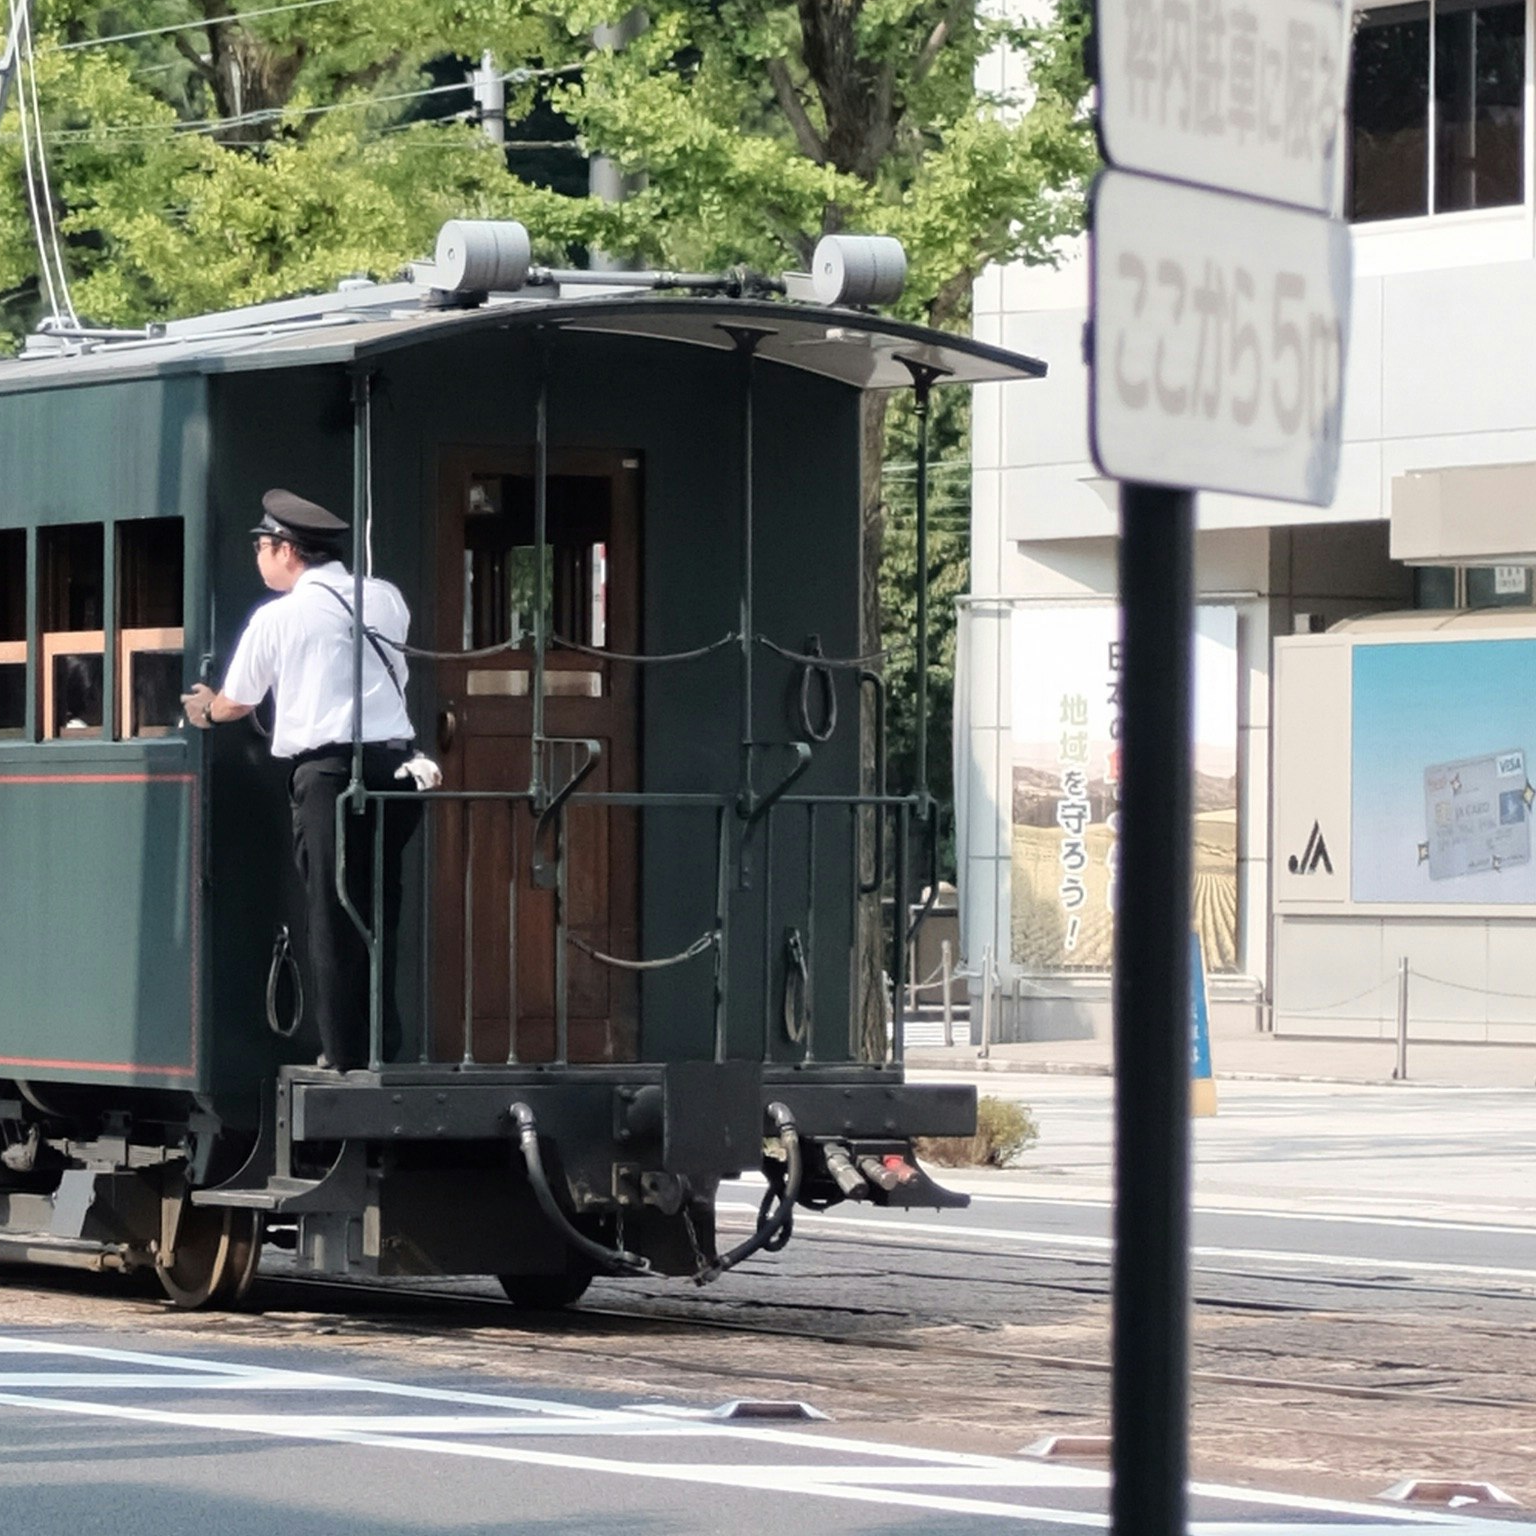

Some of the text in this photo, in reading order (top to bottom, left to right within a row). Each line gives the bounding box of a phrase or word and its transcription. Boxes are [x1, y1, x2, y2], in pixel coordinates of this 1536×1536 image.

[1114, 252, 1343, 440] ここから5m
[1059, 693, 1091, 947] 地域を守ろう!
[1499, 757, 1522, 773] VISA
